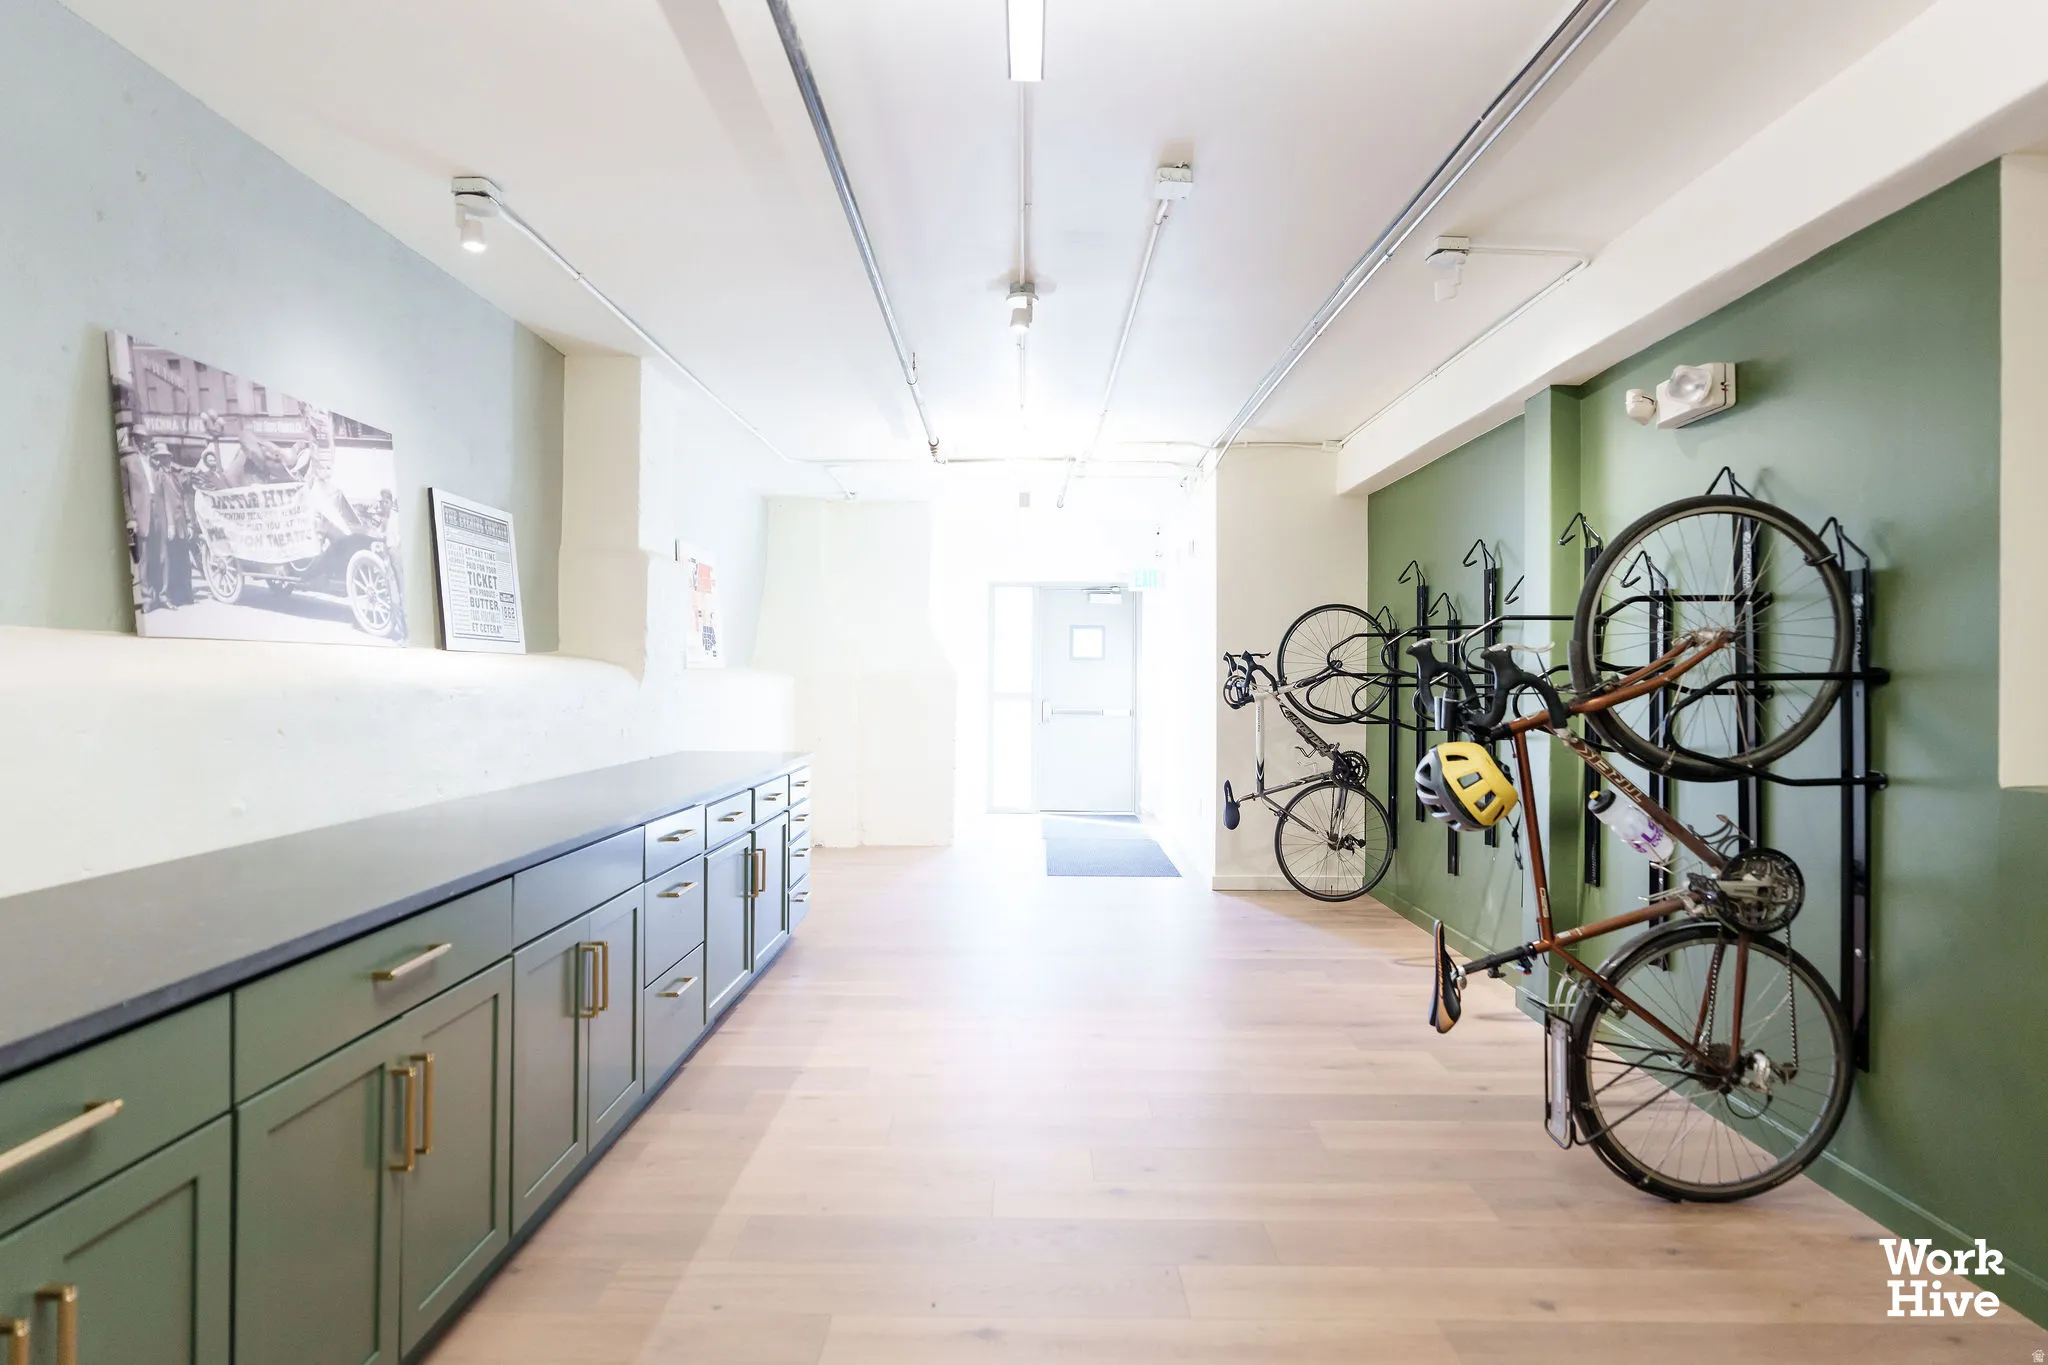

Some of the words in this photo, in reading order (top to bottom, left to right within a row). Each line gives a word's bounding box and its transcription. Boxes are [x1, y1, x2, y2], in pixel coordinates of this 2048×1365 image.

[467, 571, 498, 590] TICKET
[1134, 567, 1159, 589] EXIT
[1575, 745, 1642, 802] TREK
